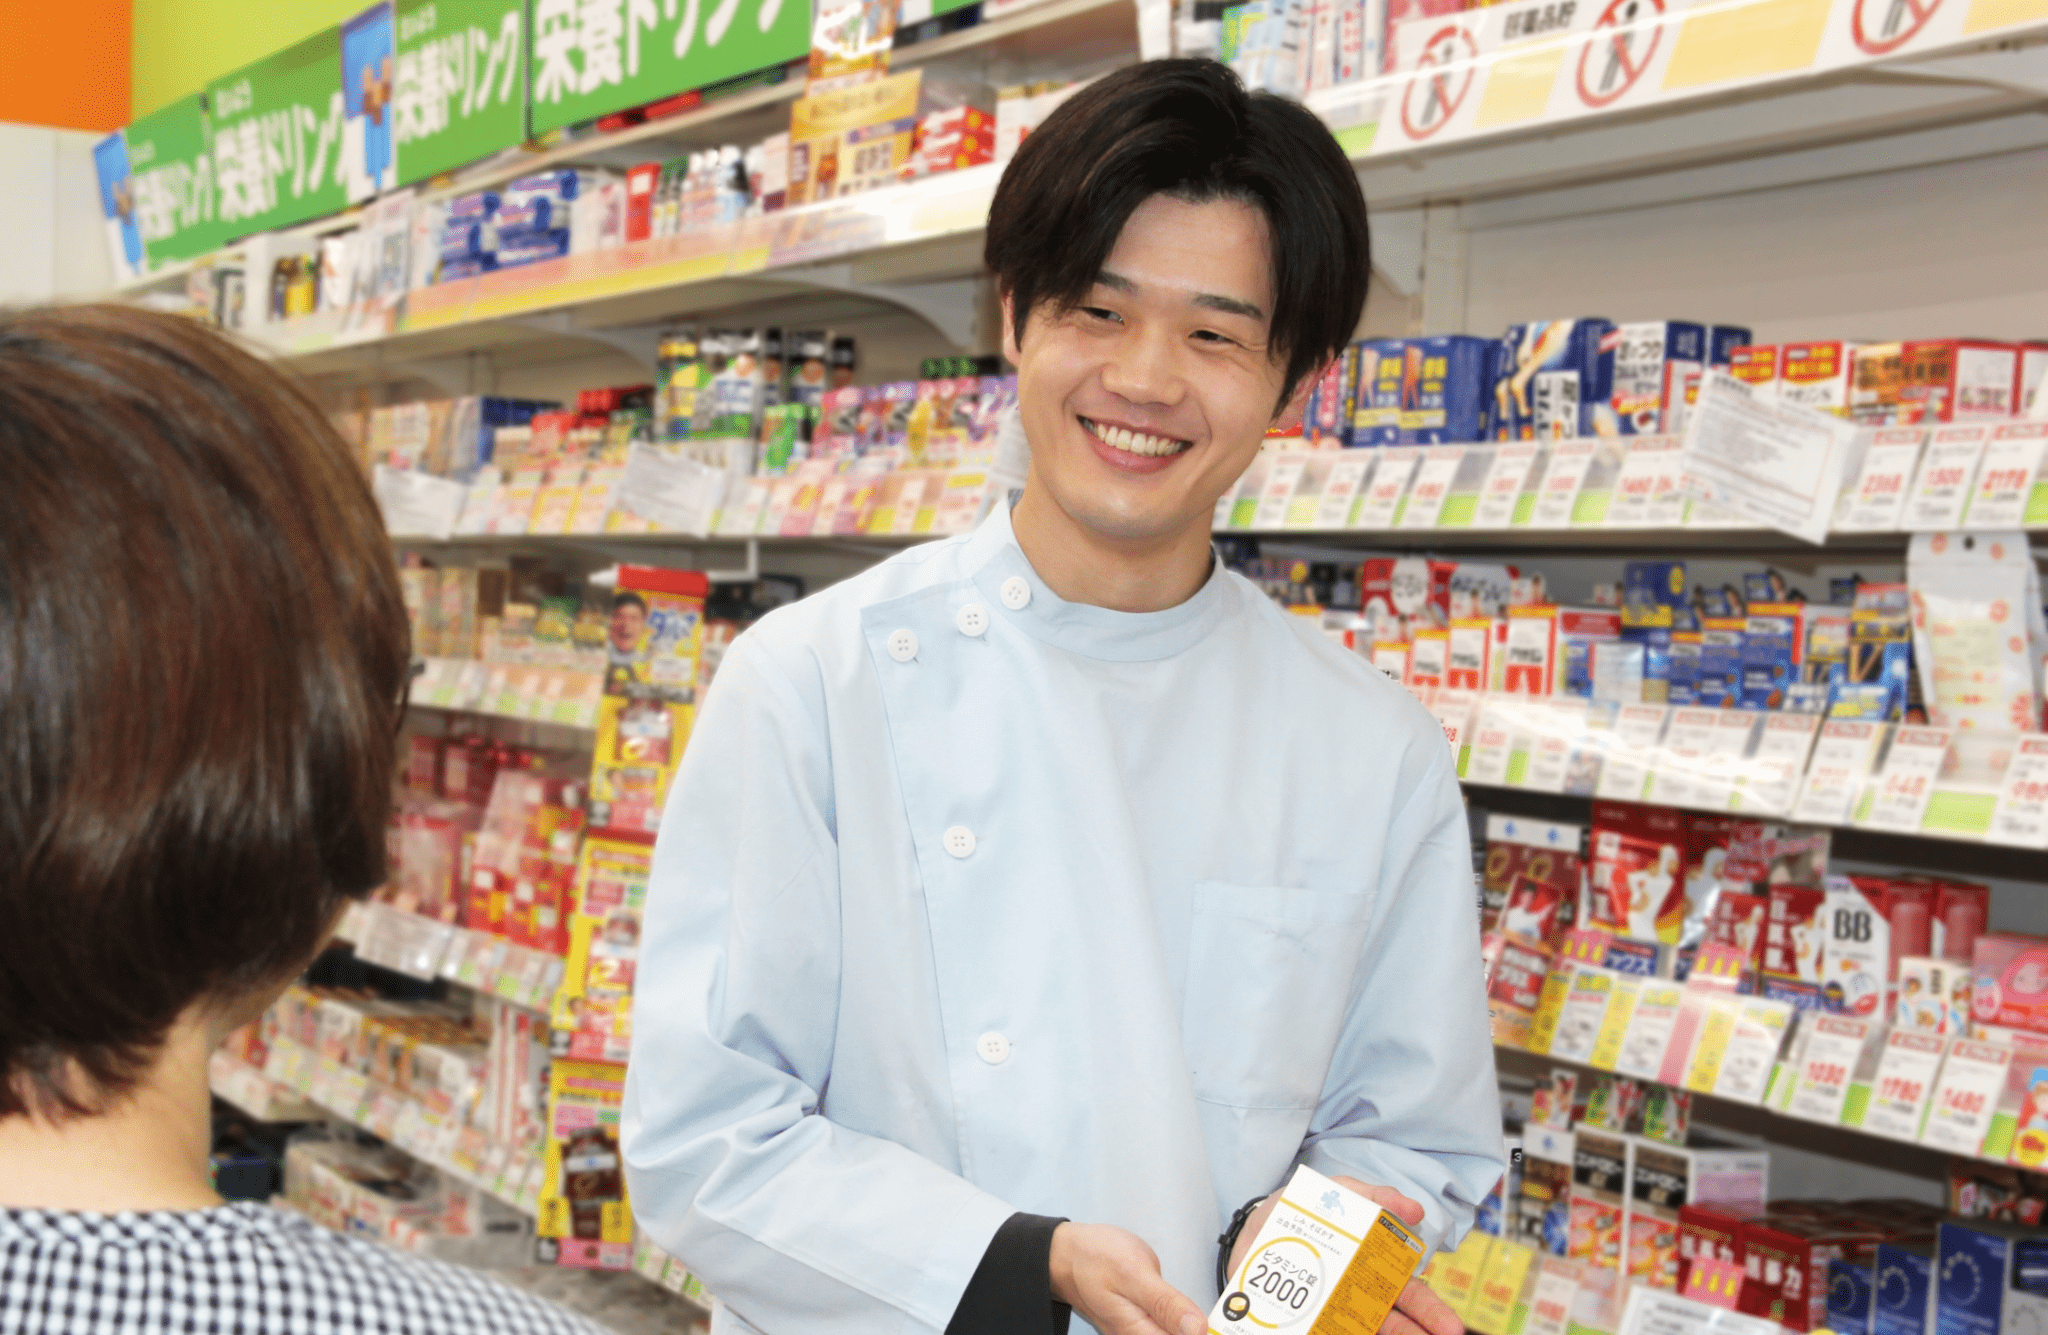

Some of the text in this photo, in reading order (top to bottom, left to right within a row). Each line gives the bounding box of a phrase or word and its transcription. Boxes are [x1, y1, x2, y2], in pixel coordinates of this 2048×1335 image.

[1834, 908, 1872, 943] BB
[1248, 1264, 1309, 1310] 2000
[1261, 1249, 1319, 1287] ビタミンC錠
